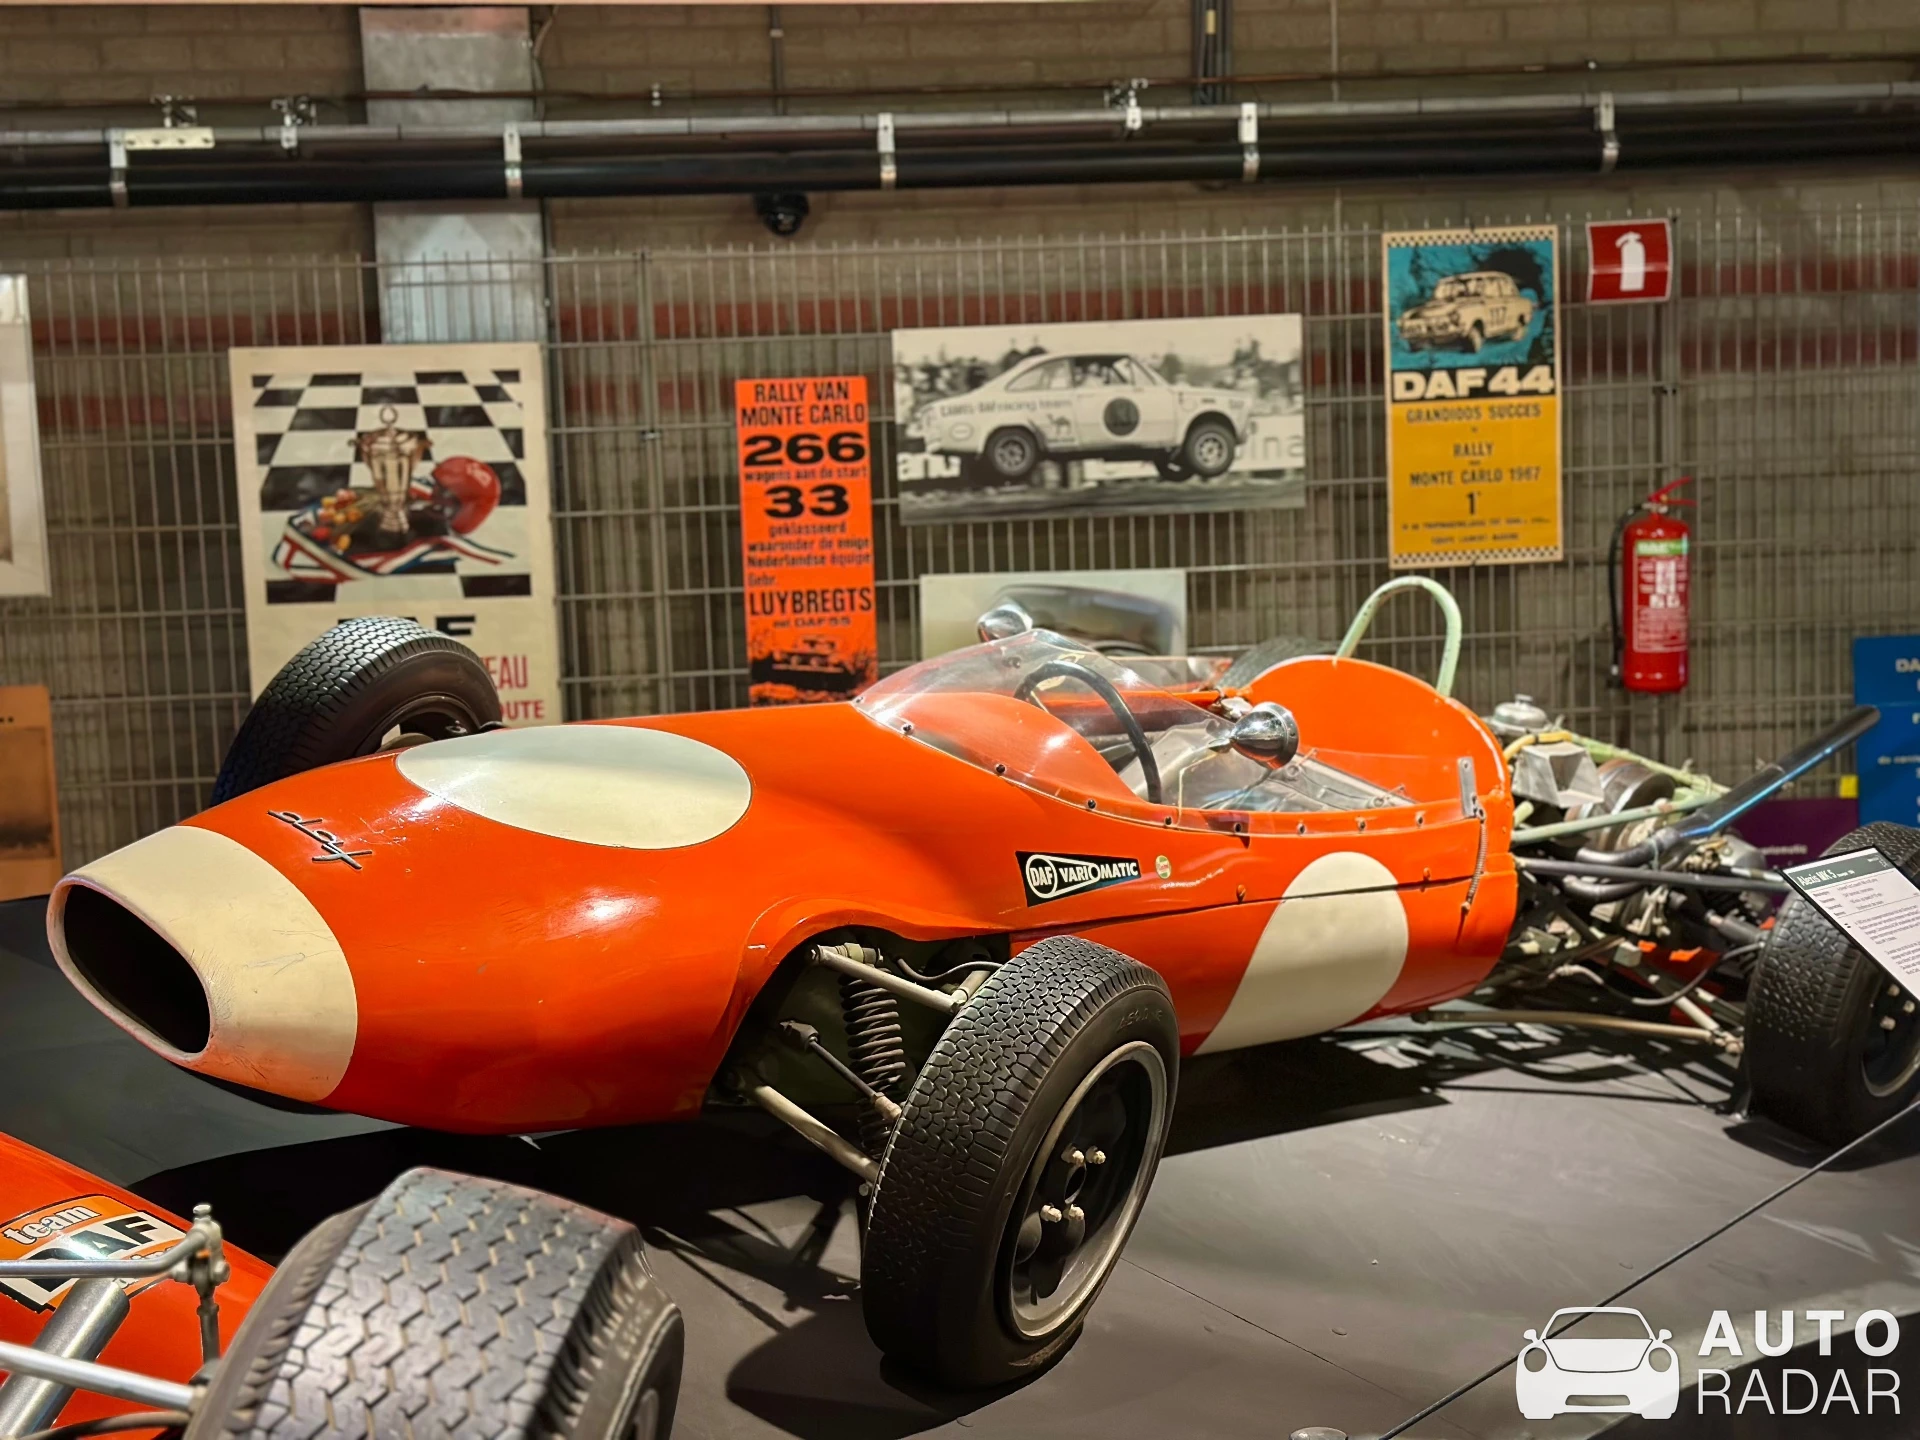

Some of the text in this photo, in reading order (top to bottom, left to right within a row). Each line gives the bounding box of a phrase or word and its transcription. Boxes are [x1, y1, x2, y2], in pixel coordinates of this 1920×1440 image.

[755, 381, 849, 402] RALLY VAN
[1392, 365, 1555, 400] DAF 44
[741, 403, 865, 427] MONTE CARLO
[744, 431, 866, 467] 266
[1453, 443, 1494, 457] RALLY
[1410, 466, 1541, 487] MONTE CARLO 1967
[764, 484, 850, 519] 33
[750, 587, 872, 616] LUYBREGTS
[1030, 865, 1053, 887] DAF
[1796, 873, 1821, 887] Alexis
[3, 1206, 101, 1245] team
